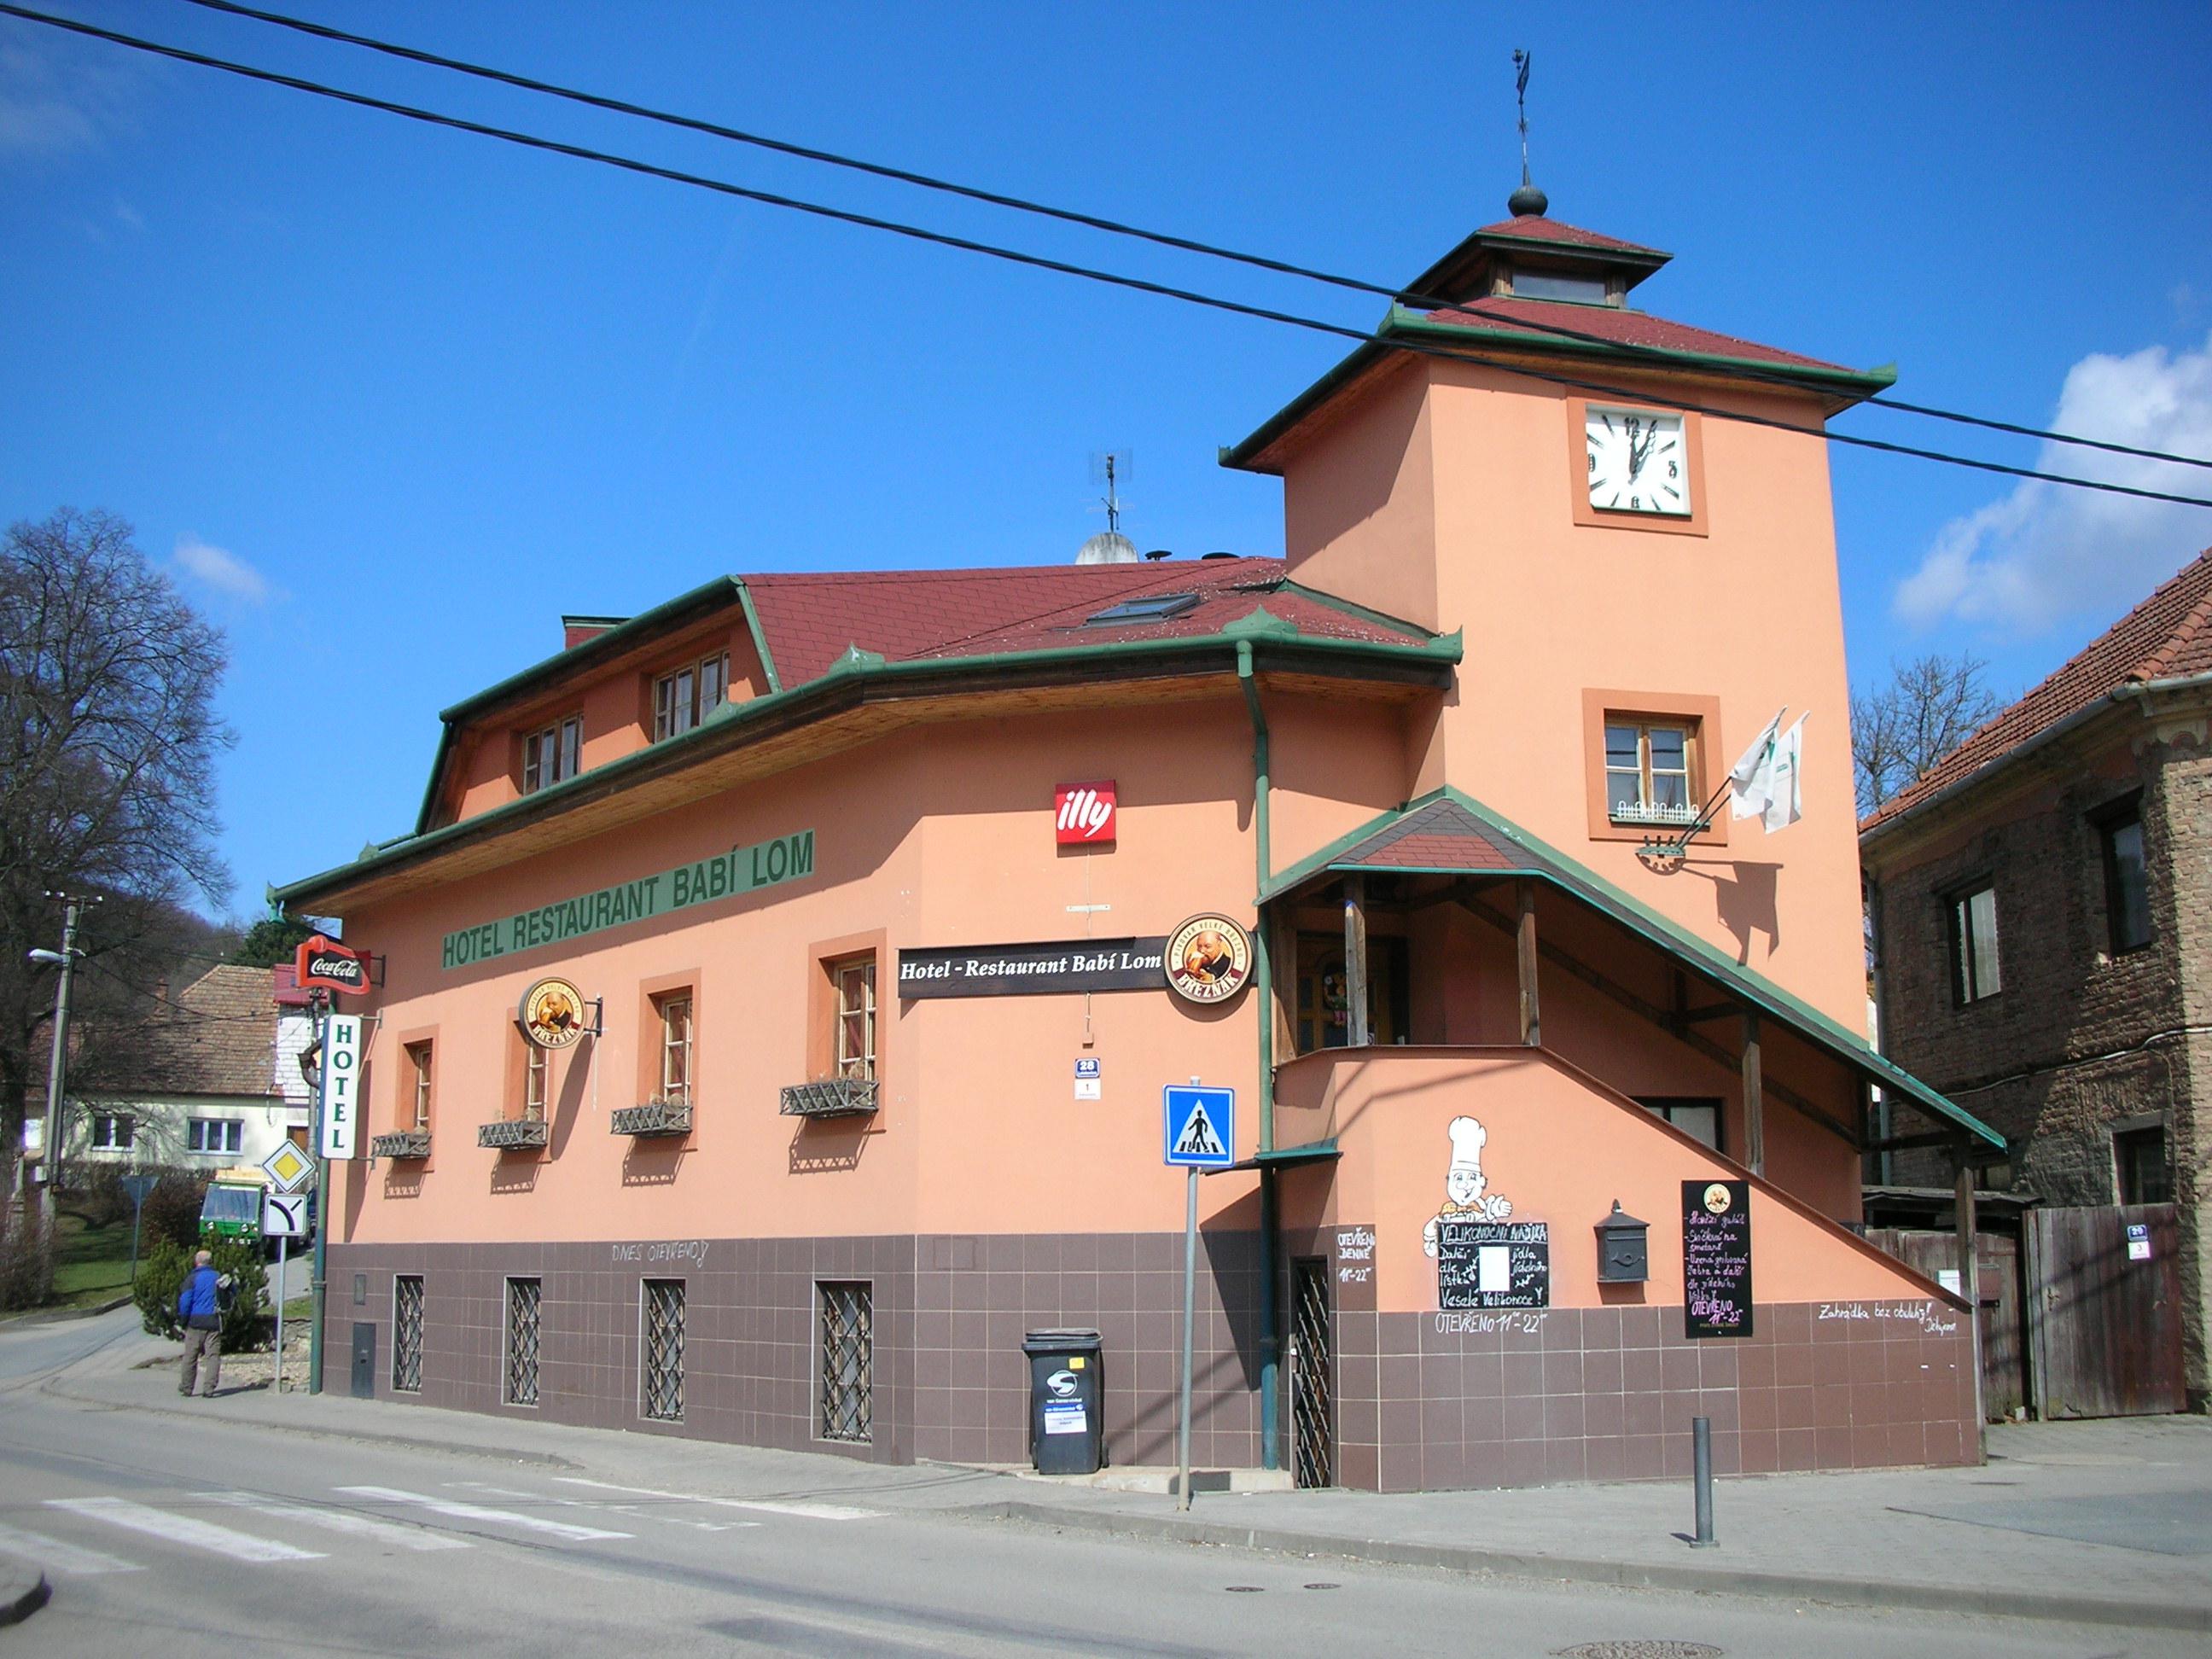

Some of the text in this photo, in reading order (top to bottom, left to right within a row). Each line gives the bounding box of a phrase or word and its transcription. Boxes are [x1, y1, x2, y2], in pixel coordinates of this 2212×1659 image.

[1057, 789, 1112, 837] illy
[443, 831, 813, 969] HOTEL RESTAURANT BABÍ LOM
[311, 958, 359, 978] Coca-Cola
[900, 961, 951, 981] Hotel
[964, 958, 1068, 977] Restaurant
[1072, 952, 1115, 973] Babí
[1121, 952, 1162, 970] Lom
[1080, 1060, 1095, 1071] 28
[332, 1024, 353, 1149] HOTEL
[612, 1243, 643, 1261] DNES
[1439, 1260, 1458, 1274] dle
[1441, 1287, 1480, 1308] Veselé
[1874, 1302, 1891, 1318] bez
[1435, 1312, 1495, 1335] OTEVŘENO
